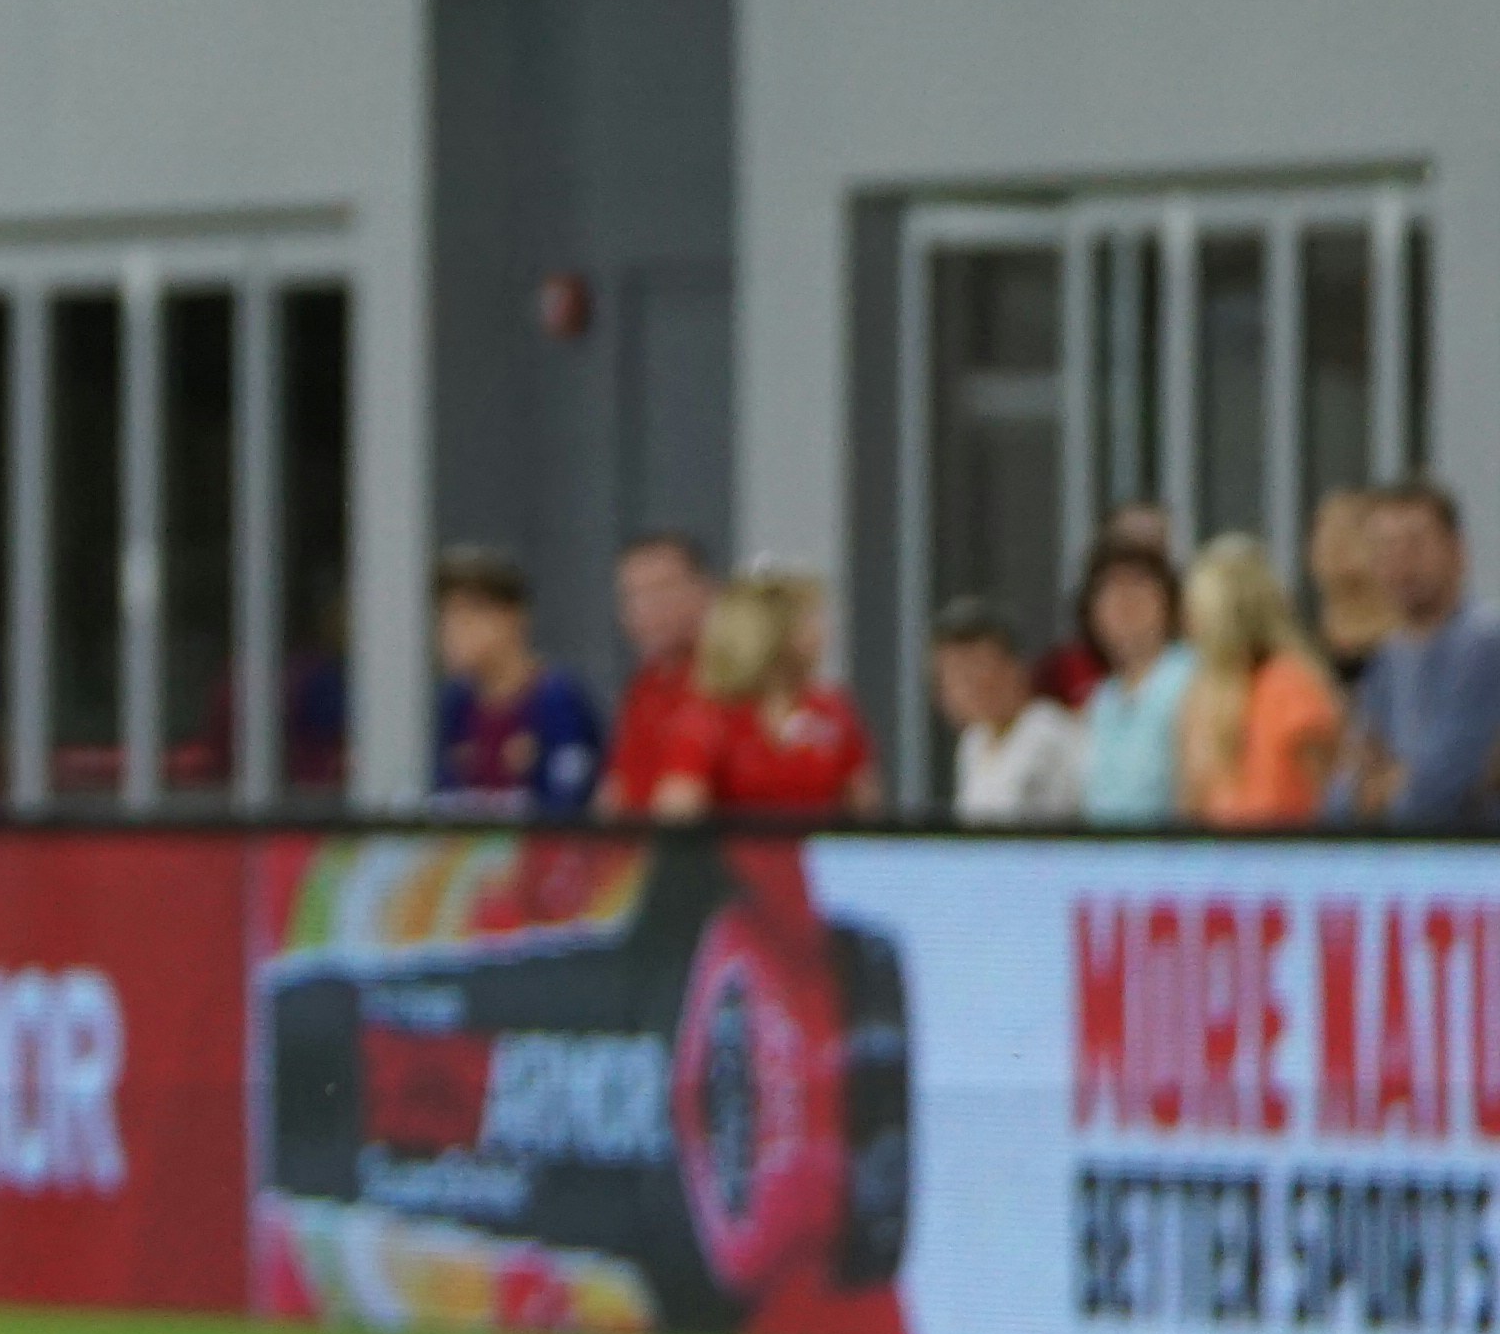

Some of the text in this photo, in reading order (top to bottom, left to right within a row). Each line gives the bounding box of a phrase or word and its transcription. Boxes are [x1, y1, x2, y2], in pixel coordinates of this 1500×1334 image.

[1073, 891, 1288, 1133] MORE
[1077, 1165, 1494, 1334] BETTER SPORTS
